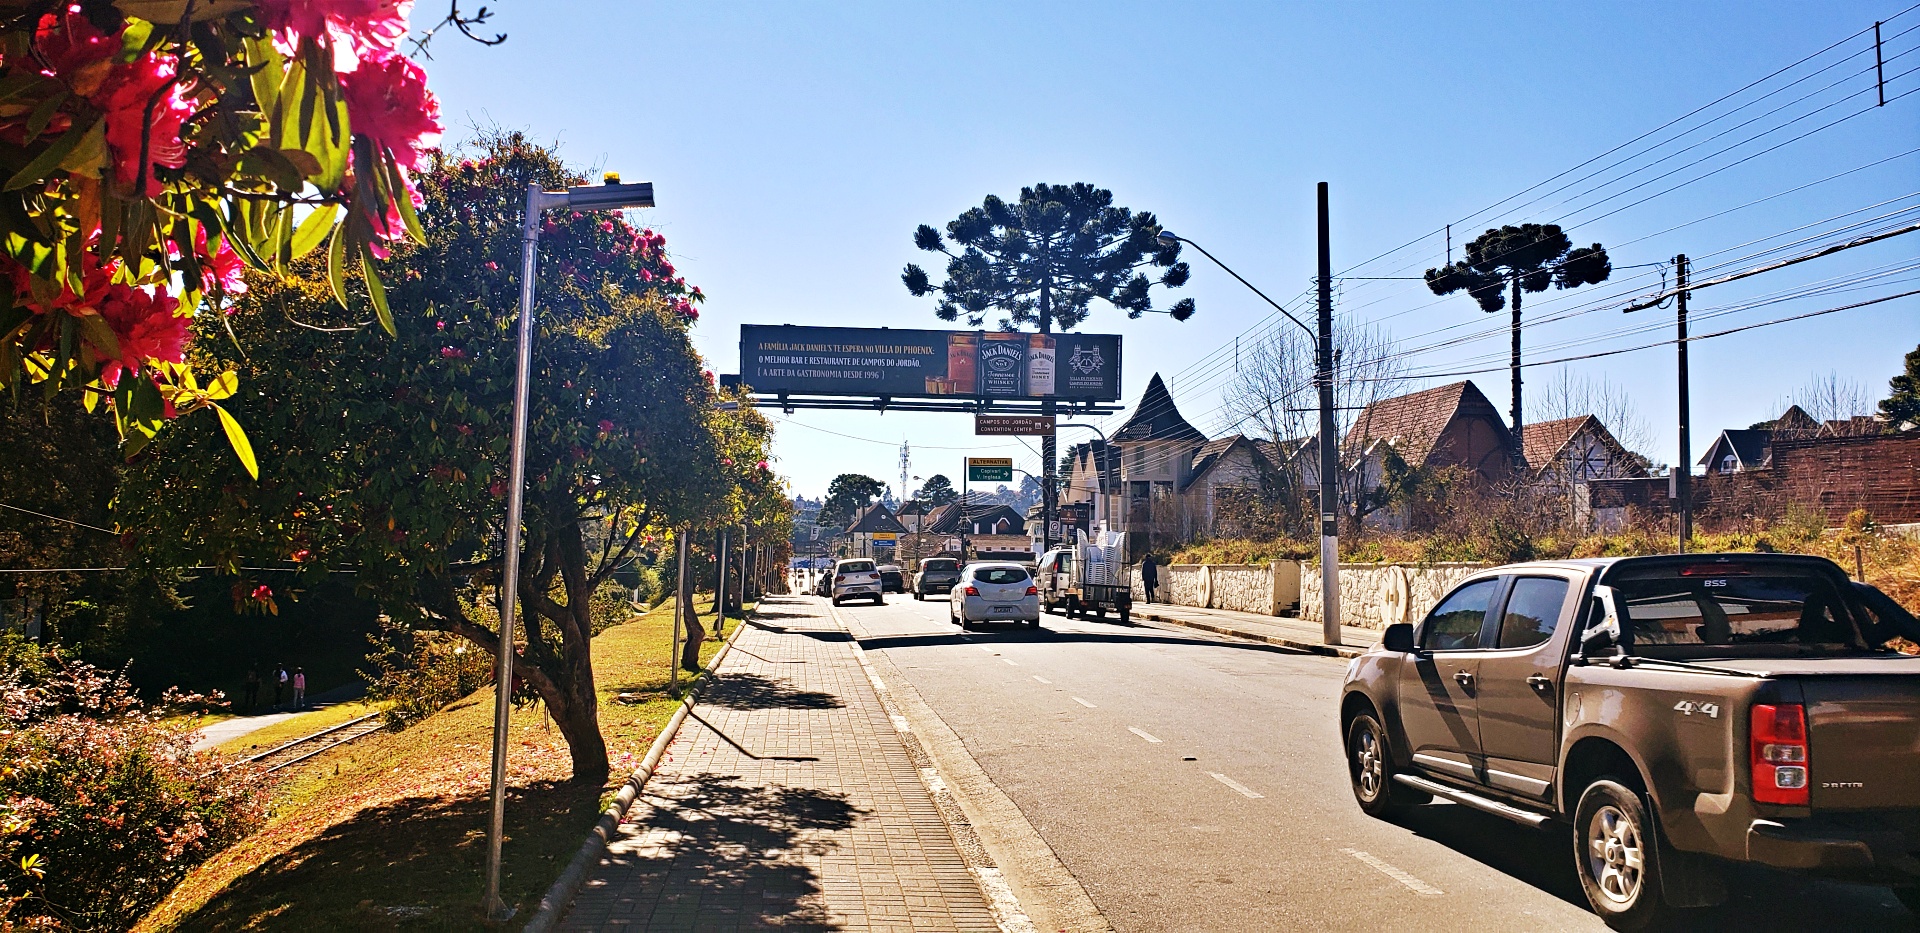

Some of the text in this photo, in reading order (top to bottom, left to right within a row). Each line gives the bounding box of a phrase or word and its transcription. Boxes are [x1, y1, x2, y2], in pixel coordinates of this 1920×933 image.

[764, 341, 788, 351] FAMÍLIA
[806, 344, 832, 352] DANIEL'S
[875, 345, 893, 354] VILLA
[895, 346, 902, 354] DI
[903, 346, 935, 354] PHOENIX:
[982, 347, 998, 360] JACK
[758, 356, 764, 364] O
[764, 356, 790, 364] MELHOR
[810, 357, 851, 366] RESTAURANTE
[861, 358, 885, 367] CAMPOS
[769, 368, 785, 377] ARTE
[797, 370, 842, 378] GASTRONOMIA
[844, 370, 862, 379] DESDE
